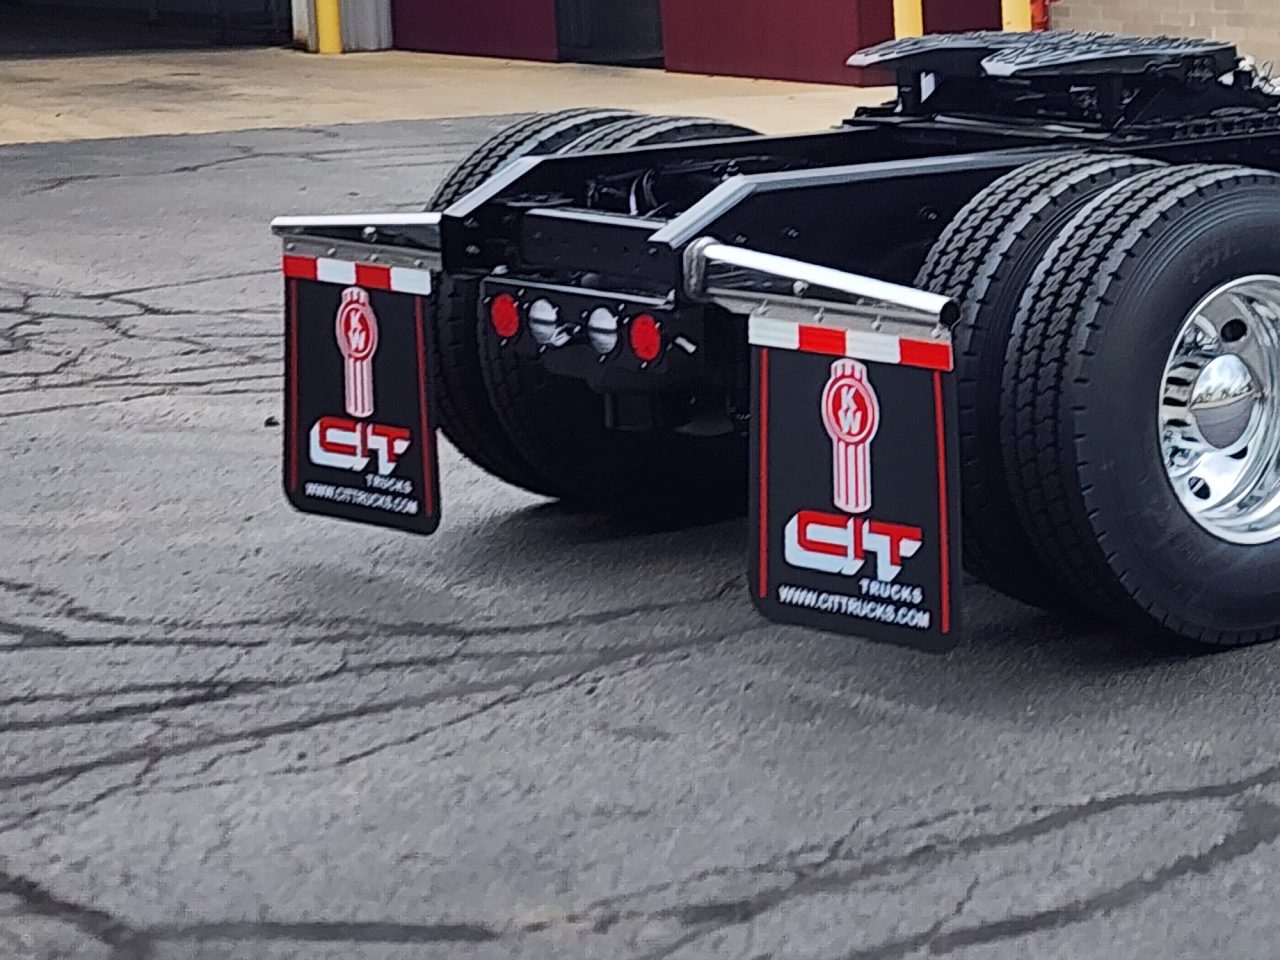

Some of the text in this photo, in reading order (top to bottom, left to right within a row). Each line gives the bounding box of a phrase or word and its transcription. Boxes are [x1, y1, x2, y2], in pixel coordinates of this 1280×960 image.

[310, 417, 411, 474] CIT
[366, 474, 413, 494] TRUCKS
[785, 510, 922, 581] CIT
[778, 584, 931, 629] WWW.CITTRUCKS.COM
[859, 578, 923, 604] TRUCKS
